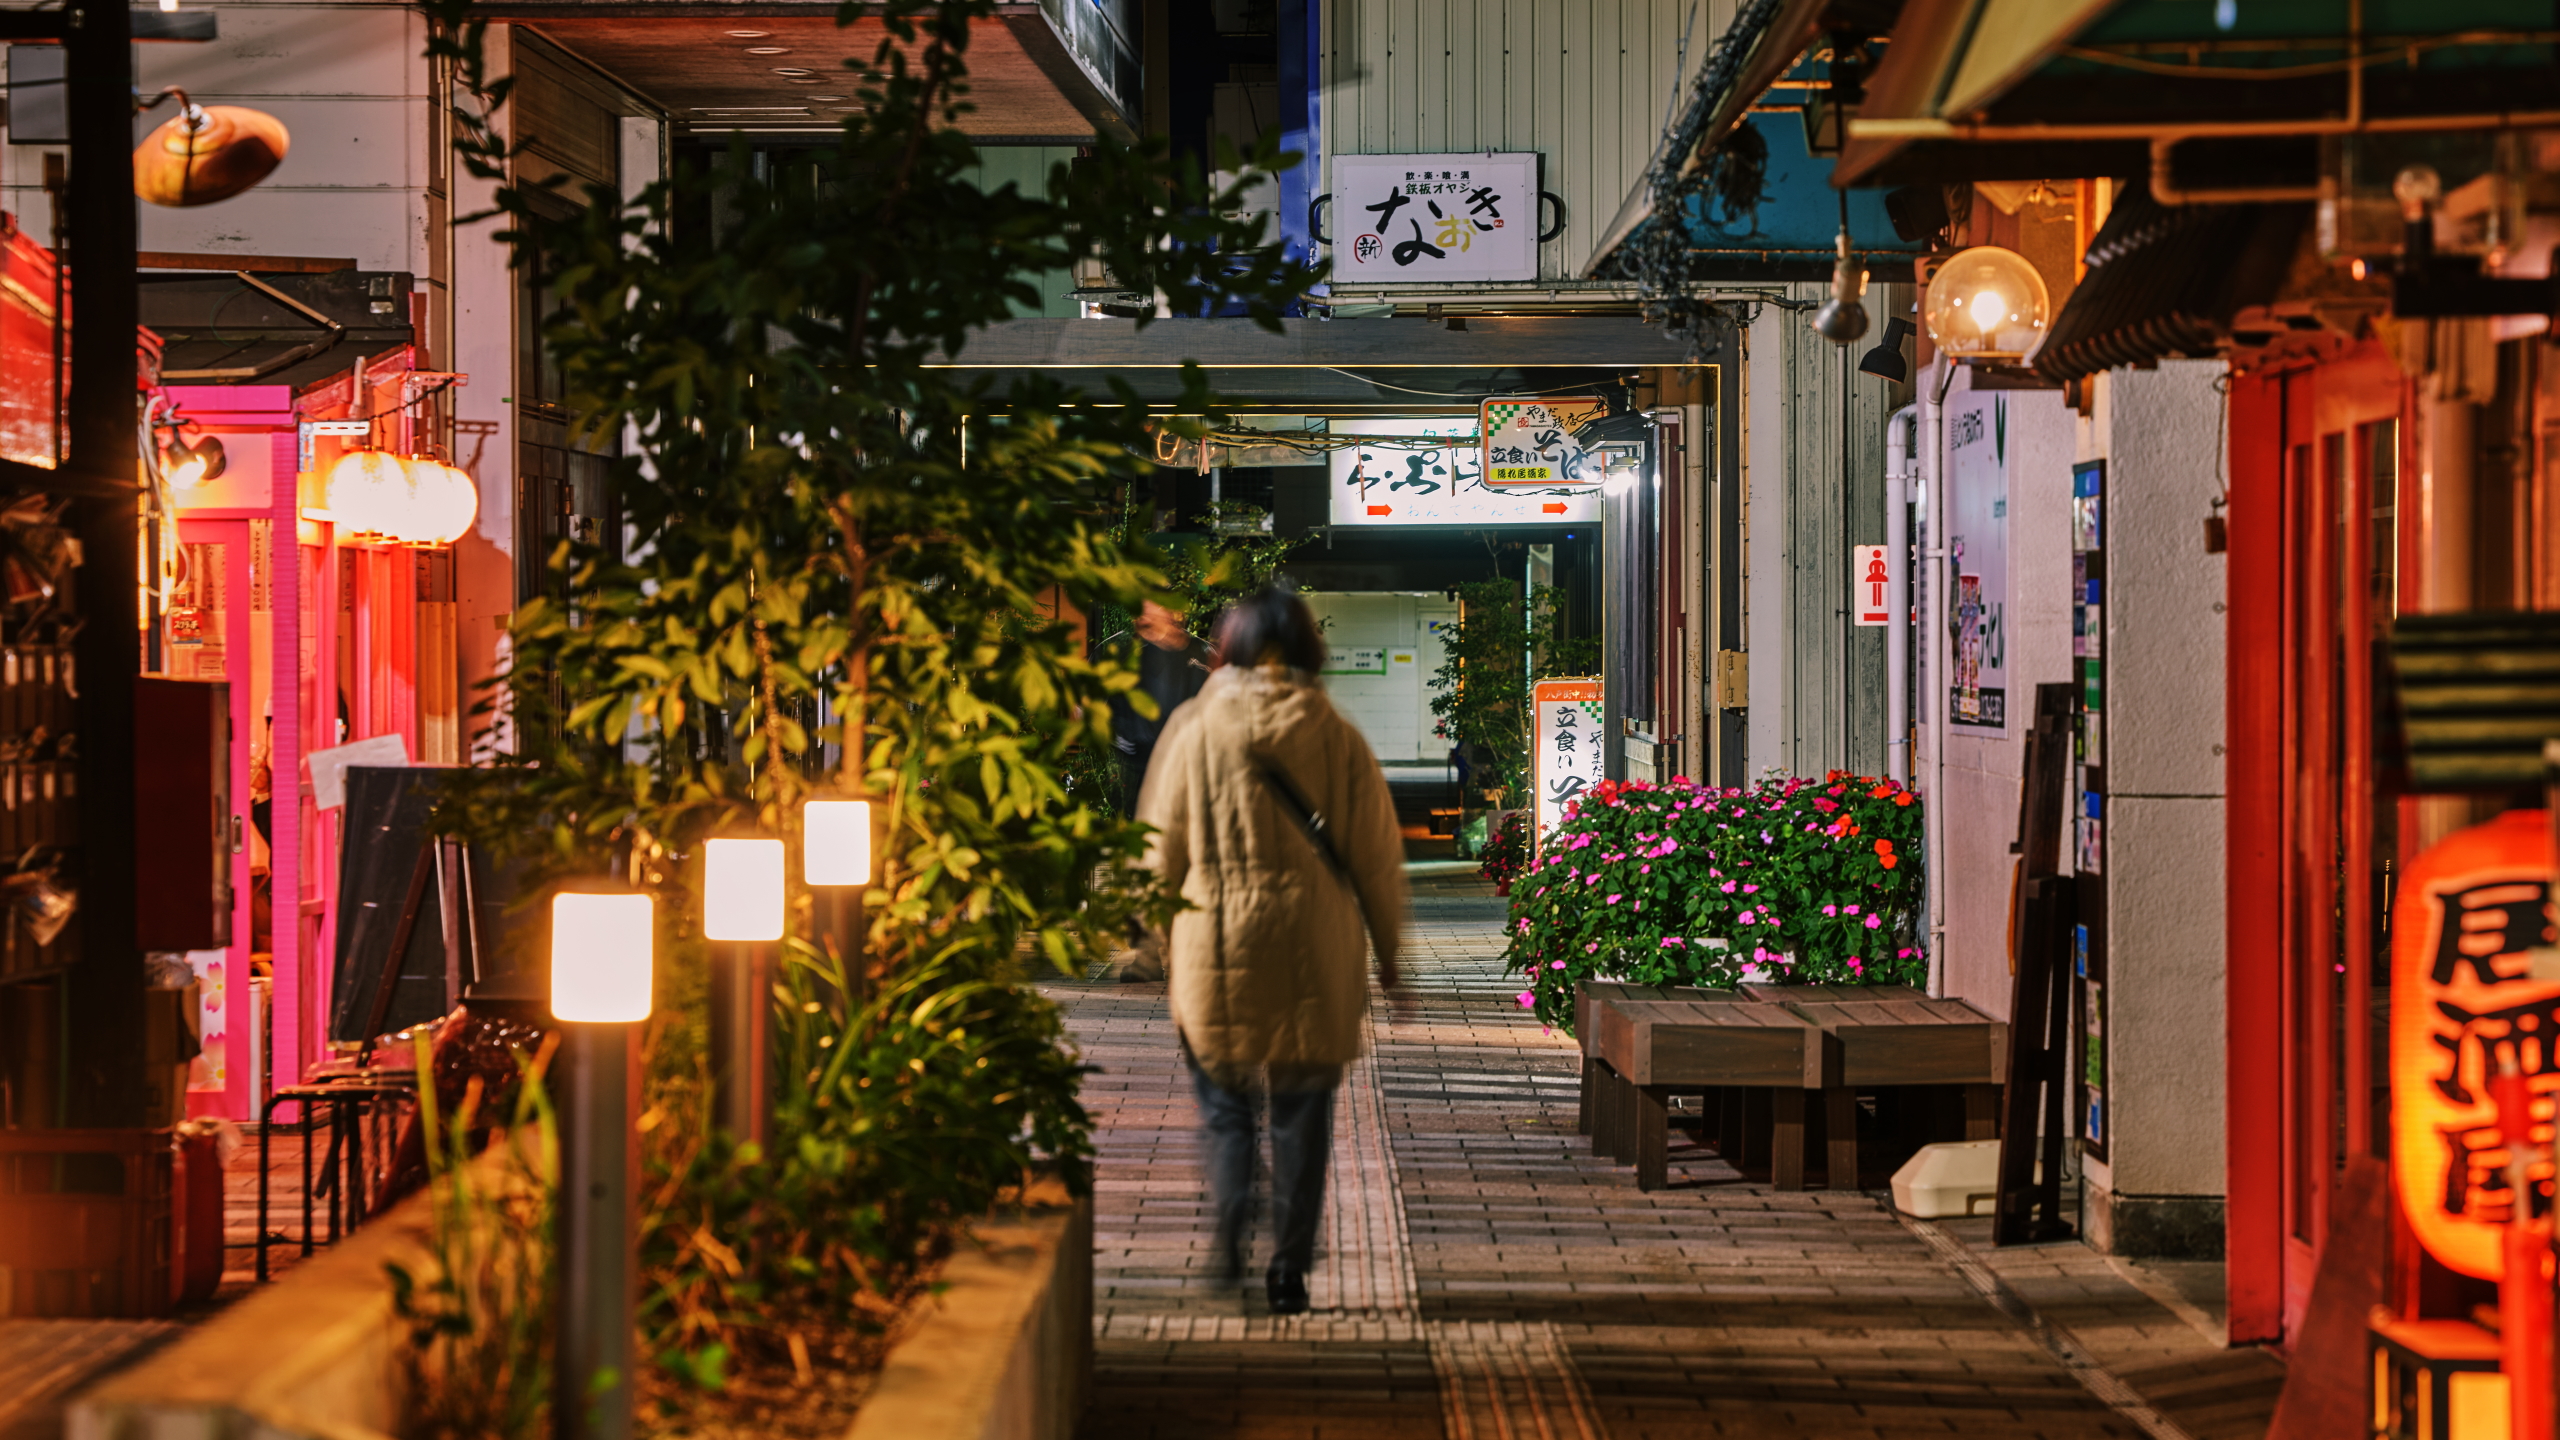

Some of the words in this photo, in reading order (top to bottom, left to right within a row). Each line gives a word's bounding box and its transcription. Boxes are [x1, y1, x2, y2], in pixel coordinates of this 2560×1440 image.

[1405, 181, 1471, 195] 鉄板オヤジ
[1357, 237, 1381, 260] 新
